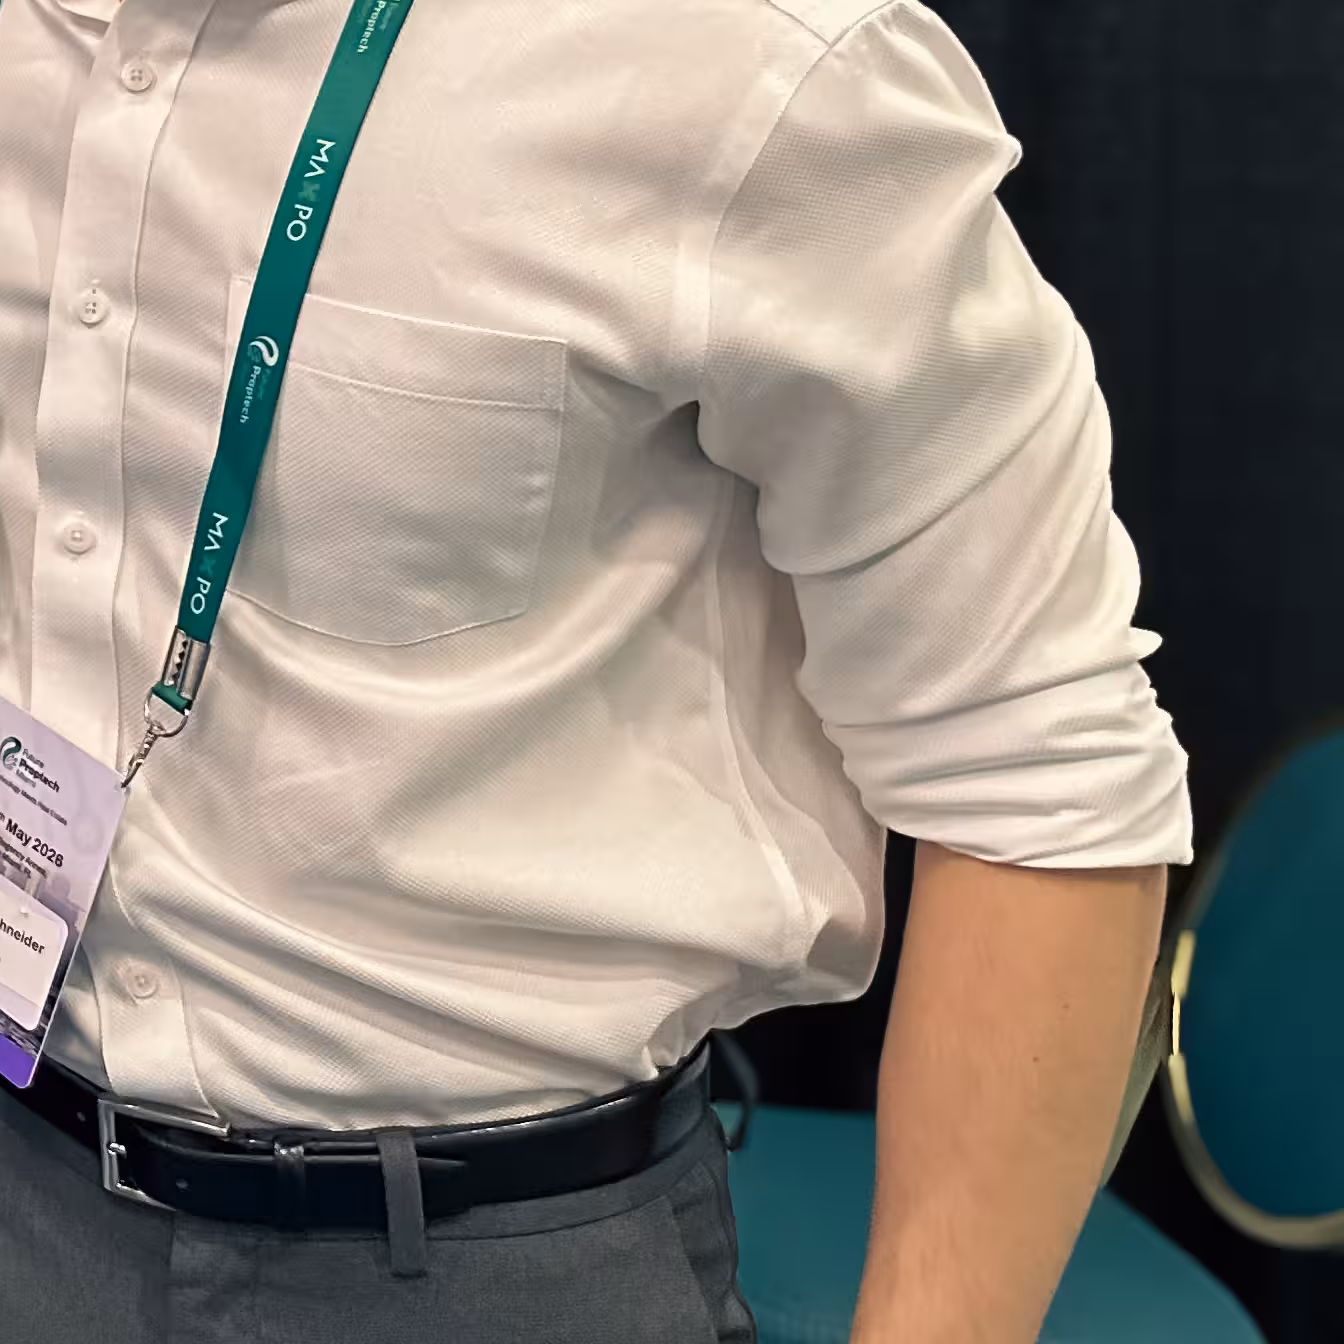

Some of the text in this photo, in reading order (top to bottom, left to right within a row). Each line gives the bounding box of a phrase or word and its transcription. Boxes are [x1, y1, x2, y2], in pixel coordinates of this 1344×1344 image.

[357, 0, 386, 53] Proptech
[240, 365, 261, 424] Proptech
[19, 758, 60, 792] Proptech
[6, 819, 32, 846] May
